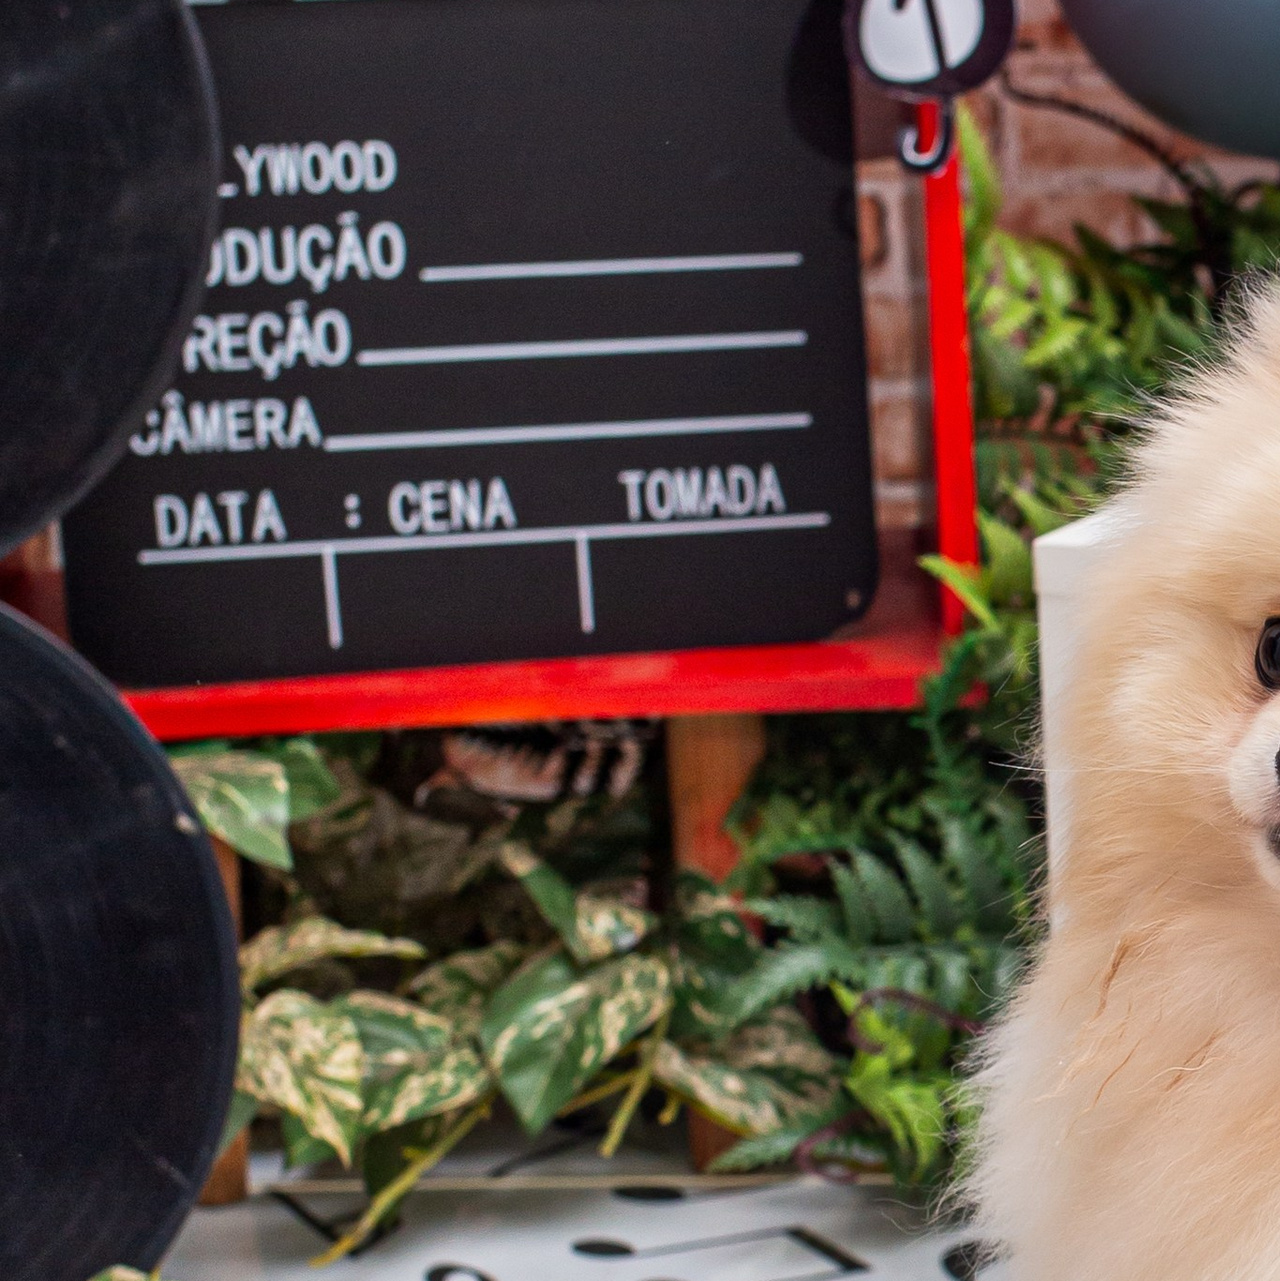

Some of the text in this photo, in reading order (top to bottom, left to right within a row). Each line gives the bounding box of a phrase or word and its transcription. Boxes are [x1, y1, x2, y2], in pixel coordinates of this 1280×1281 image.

[217, 139, 397, 196] YWOOD
[153, 489, 288, 548] DATA
[388, 478, 517, 535] CENA
[617, 463, 786, 521] TOMADA
